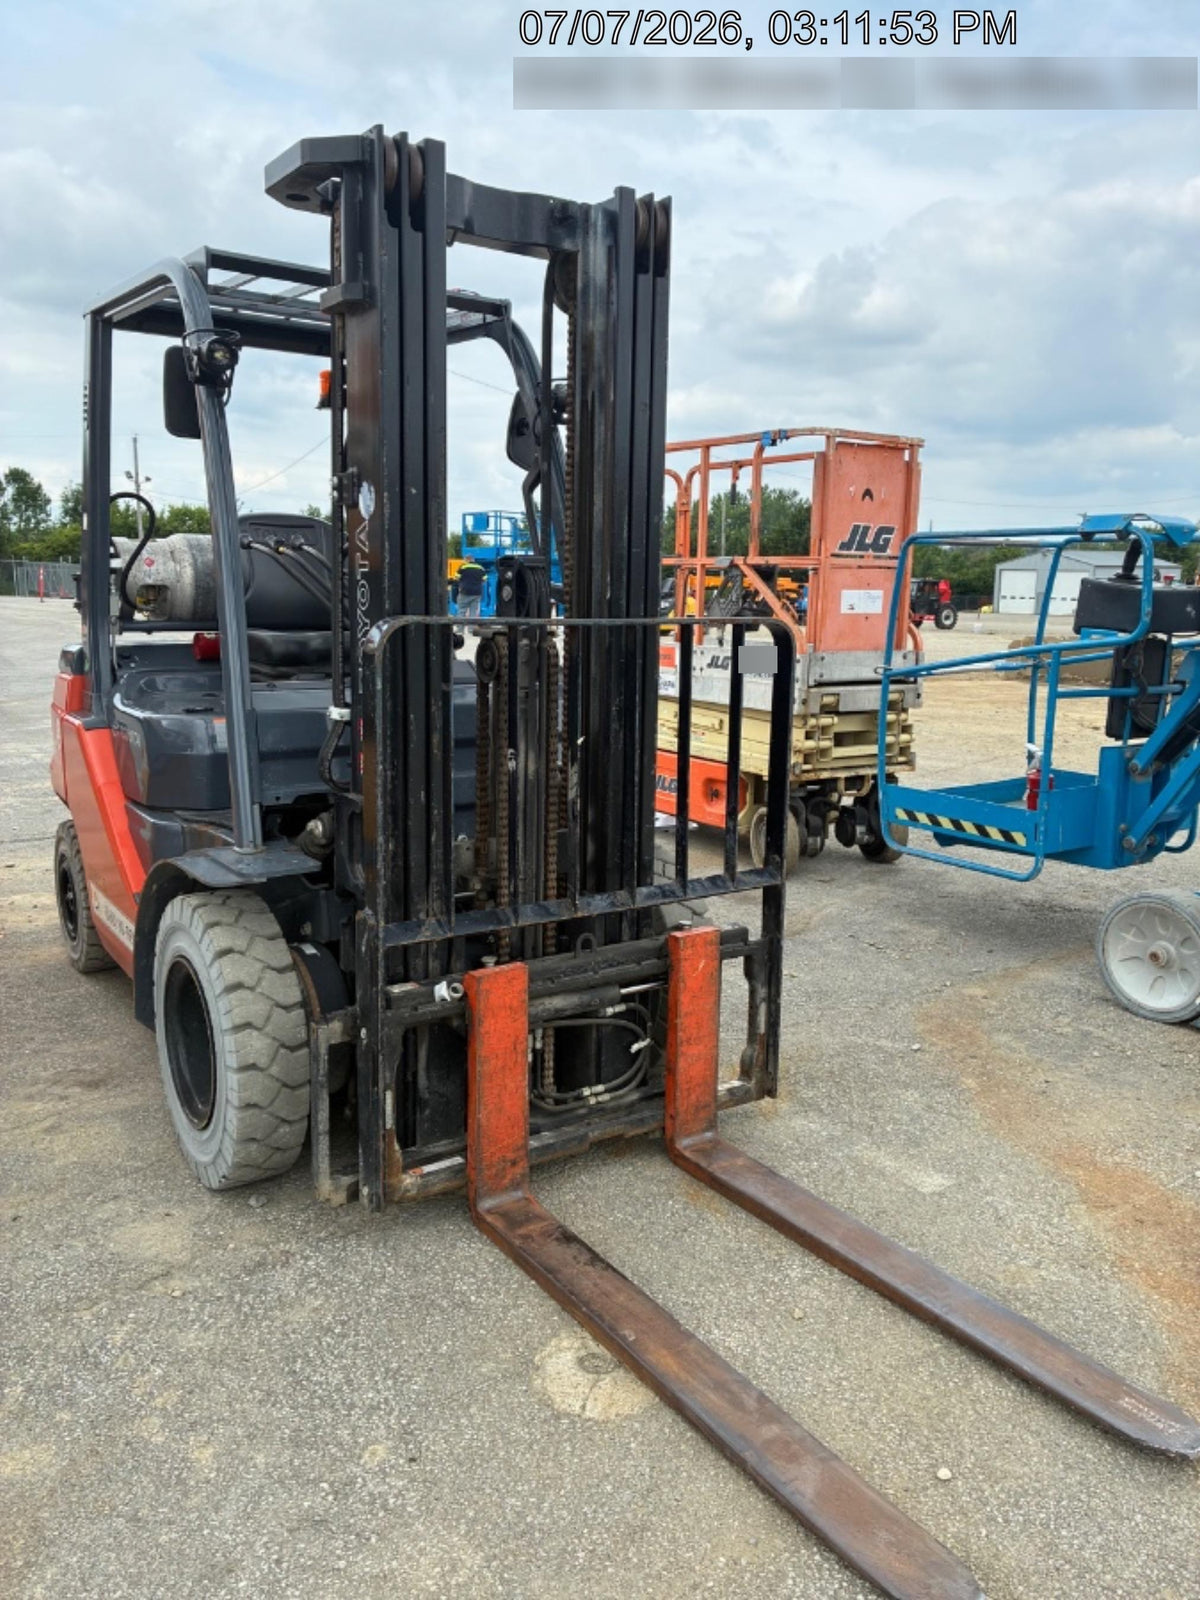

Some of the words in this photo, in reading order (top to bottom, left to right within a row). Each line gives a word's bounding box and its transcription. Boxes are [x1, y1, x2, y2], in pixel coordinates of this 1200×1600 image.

[836, 523, 897, 555] JLG
[355, 520, 371, 694] YOTA
[706, 654, 732, 671] JLG
